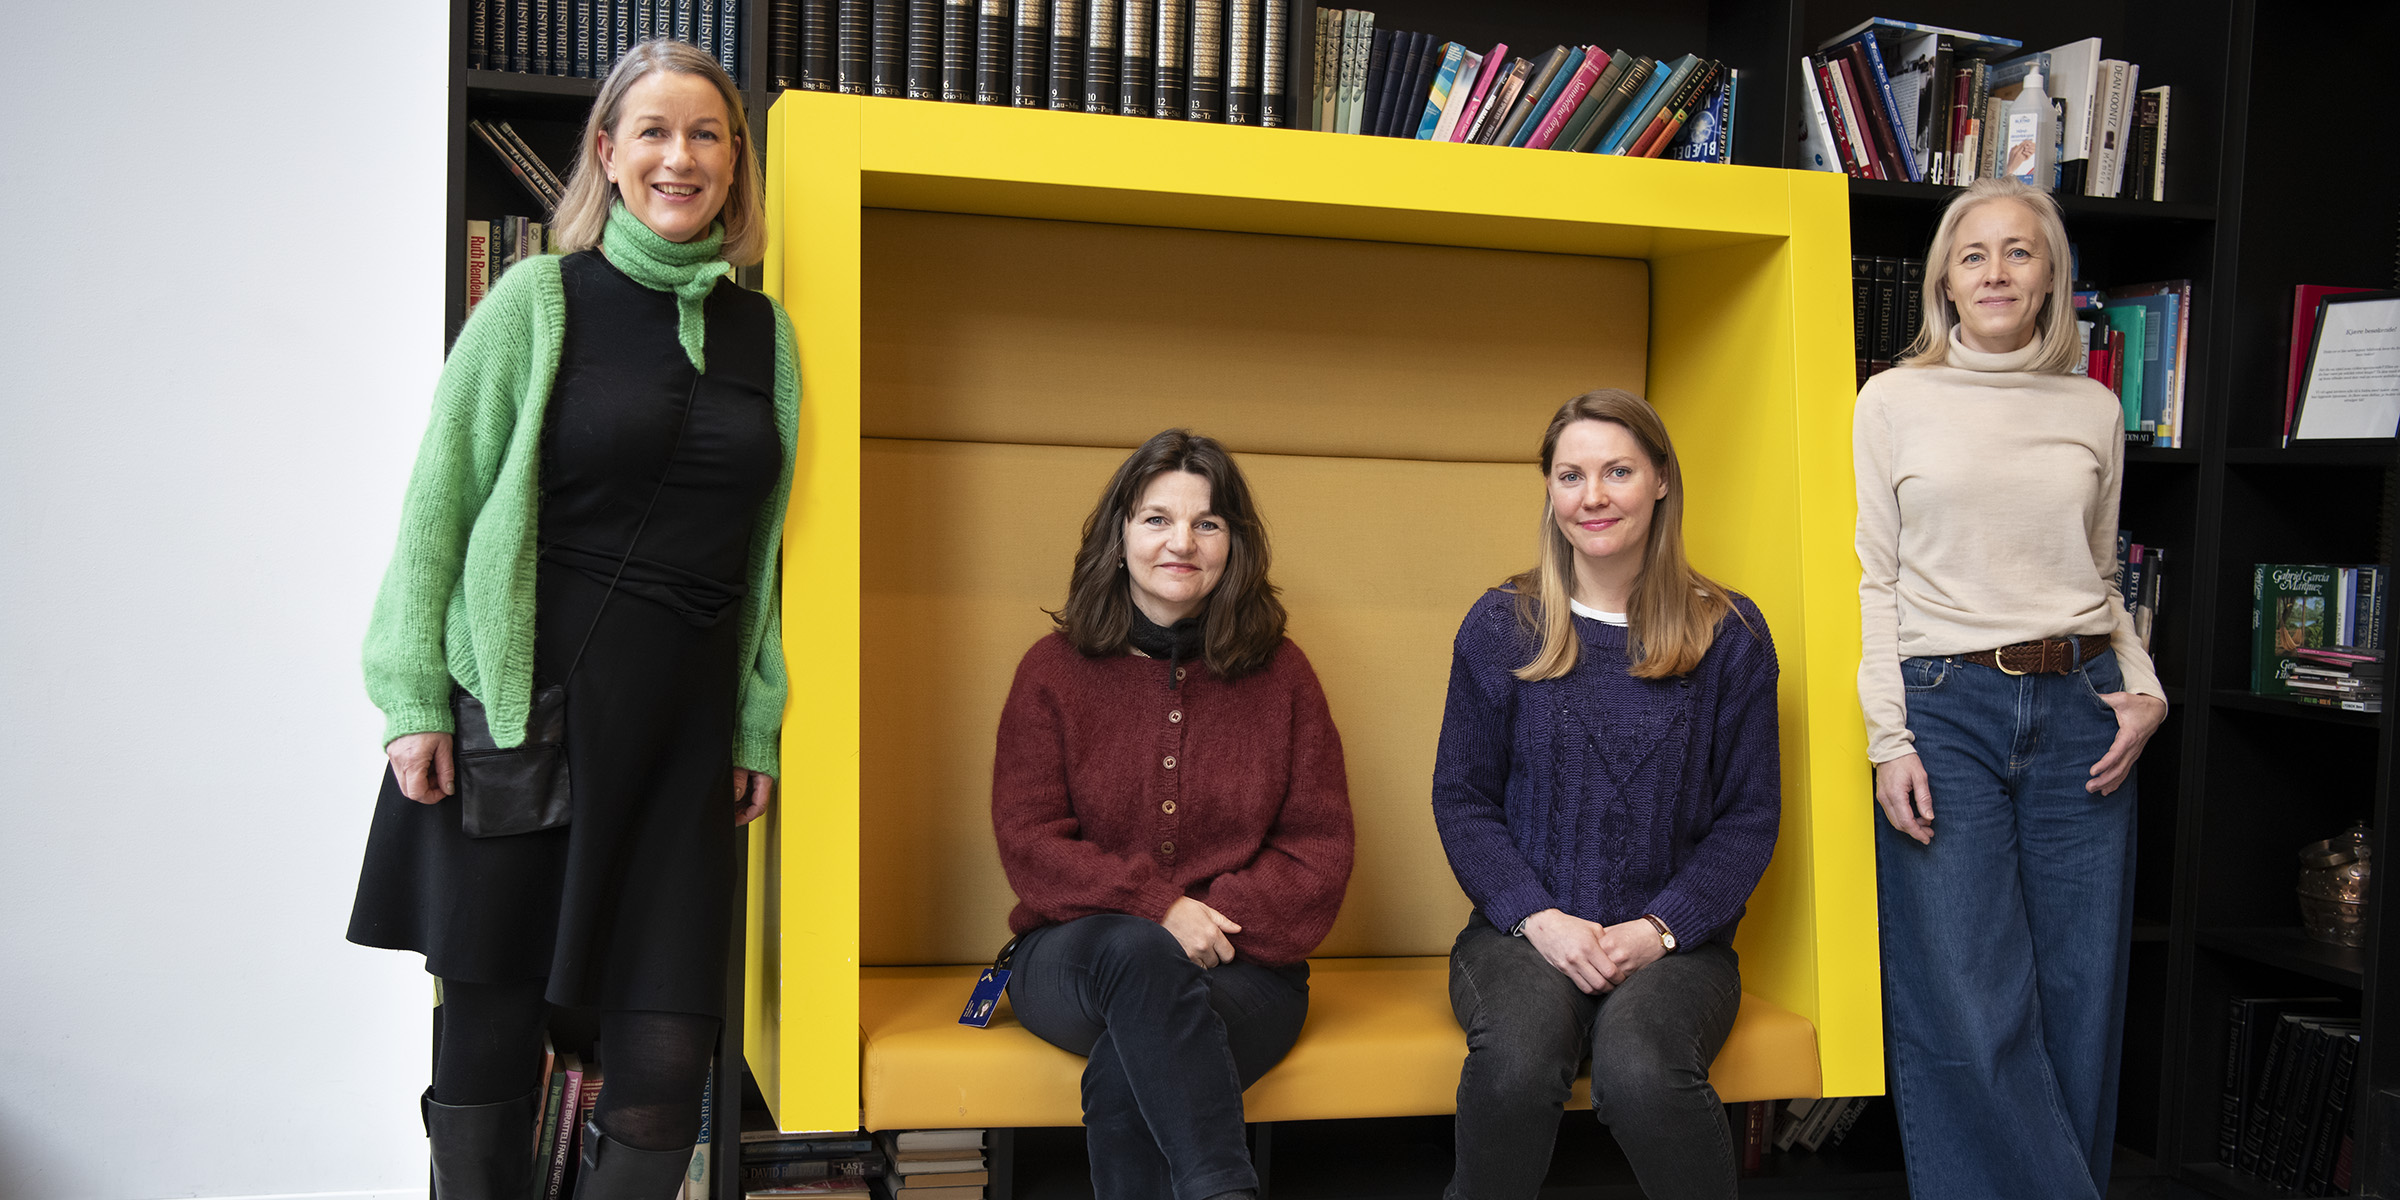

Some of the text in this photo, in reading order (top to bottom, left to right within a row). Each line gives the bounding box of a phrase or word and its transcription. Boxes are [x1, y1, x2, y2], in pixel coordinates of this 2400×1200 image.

[474, 0, 485, 45] STORIE
[494, 0, 505, 51] ISTORIE
[577, 2, 590, 60] HISTORIE
[596, 4, 608, 62] HISTORIE
[723, 15, 736, 72] HISTORIE
[803, 70, 809, 78] 2
[840, 72, 846, 82] 3
[874, 75, 881, 83] 4
[909, 78, 916, 87] 5
[1692, 68, 1705, 83] TOVE
[1705, 69, 1718, 83] TOVE
[943, 80, 949, 89] 6
[979, 83, 985, 91] 7
[1014, 86, 1021, 95] 8
[1051, 89, 1058, 97] 9
[1087, 93, 1097, 102] 10
[1123, 95, 1132, 104] 11
[1157, 97, 1166, 106] 12
[1191, 100, 1200, 109] 13
[1688, 85, 1705, 107] NILSEN
[2107, 65, 2123, 127] DEAN KOONTZ
[1229, 104, 1238, 112] 14
[1263, 106, 1273, 114] 15
[1543, 79, 1586, 141] Sannhetens torner
[1831, 105, 1846, 143] Cars
[1717, 126, 1727, 153] BLÆDEL
[1673, 141, 1717, 160] BLÆDEL
[509, 149, 552, 195] SAINT MAUD
[491, 225, 501, 280] SIGURD EVENS
[469, 236, 486, 296] Ruth Rendell
[1855, 286, 1868, 350] Britannica
[1878, 287, 1893, 352] Britannica
[1906, 289, 1919, 347] Britannic
[2129, 571, 2140, 599] BYTE
[2272, 569, 2303, 585] Gabriel
[2372, 618, 2380, 648] HEYERD
[565, 1077, 579, 1109] TRYGVE
[559, 1108, 574, 1145] BRATTELI
[1832, 1106, 1852, 1134] JOHN
[554, 1143, 566, 1165] FANGE
[750, 1166, 779, 1179] DAVID
[840, 1161, 864, 1169] LAST
[844, 1168, 864, 1176] MILE
[550, 1169, 561, 1184] NATT
[548, 1183, 558, 1195] OG
